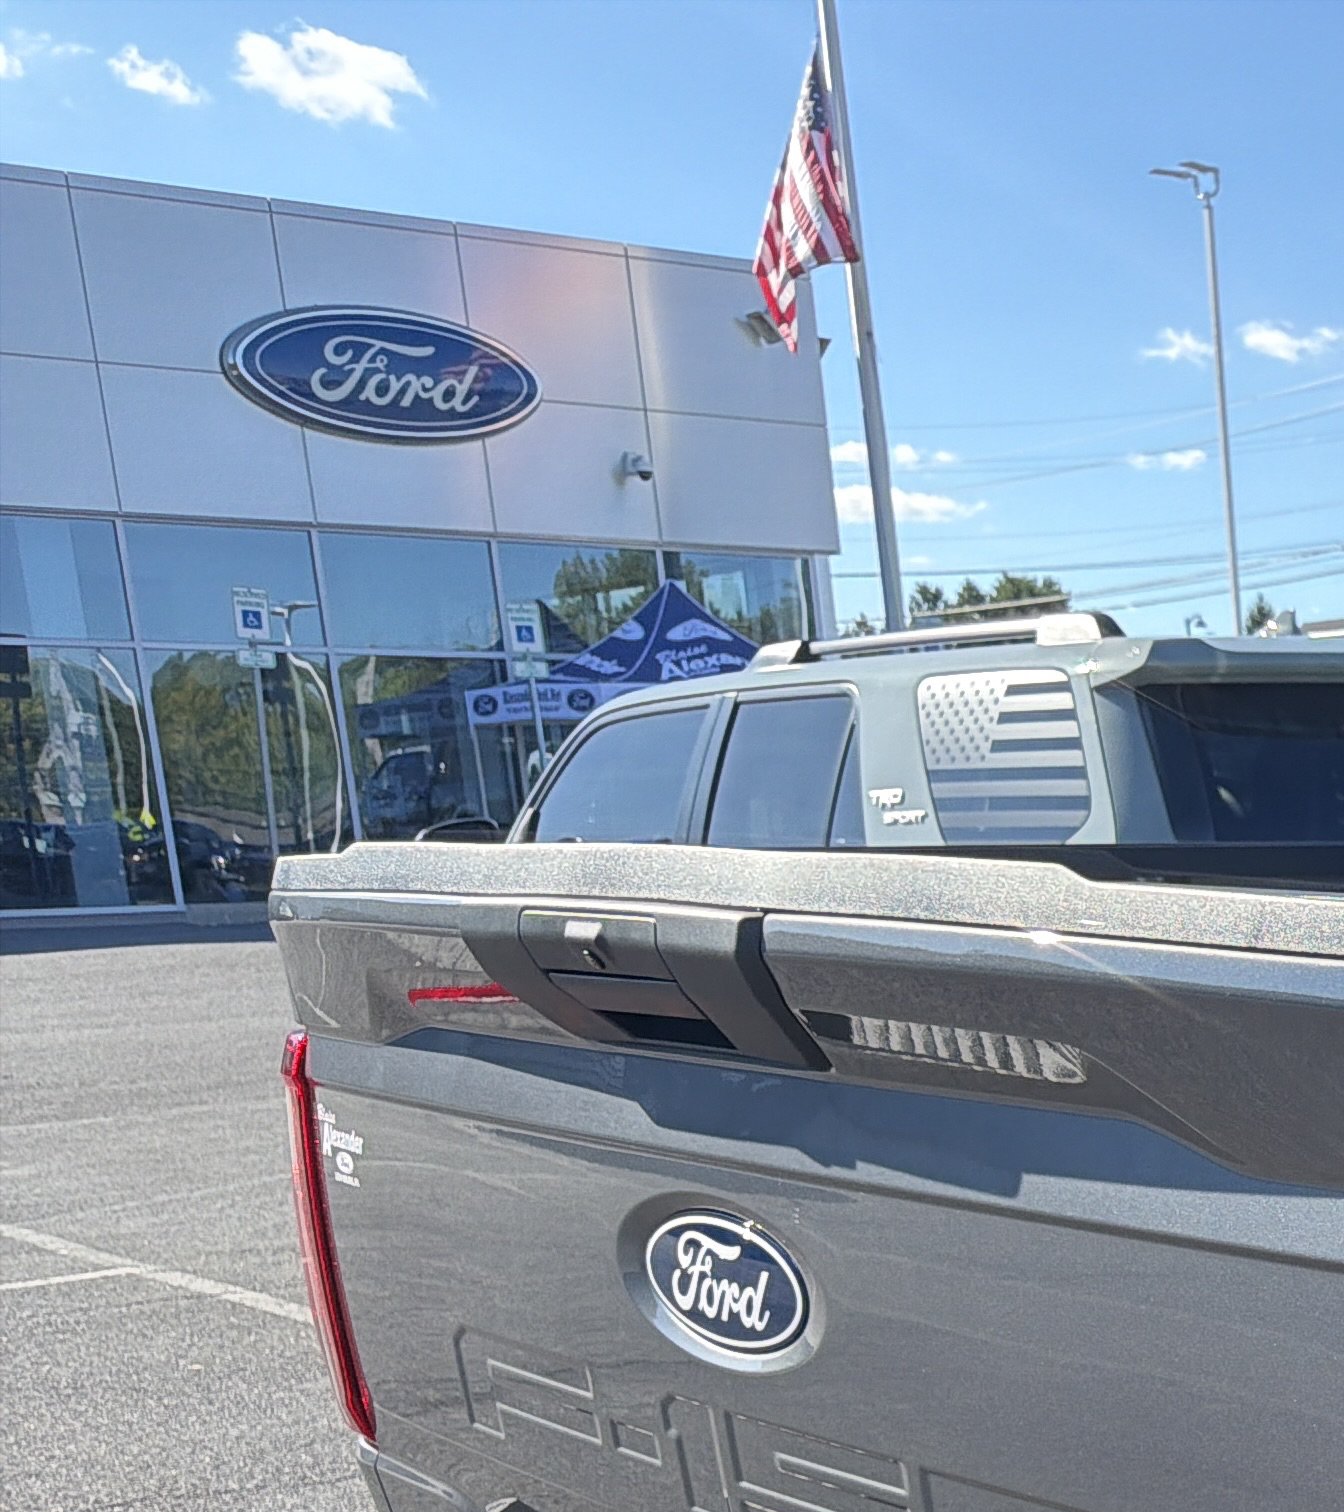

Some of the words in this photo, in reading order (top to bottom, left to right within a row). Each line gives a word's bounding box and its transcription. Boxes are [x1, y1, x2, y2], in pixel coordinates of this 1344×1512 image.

[310, 335, 480, 413] Ford
[868, 788, 903, 808] TRD
[883, 809, 926, 825] SPORT
[671, 1228, 770, 1332] Ford
